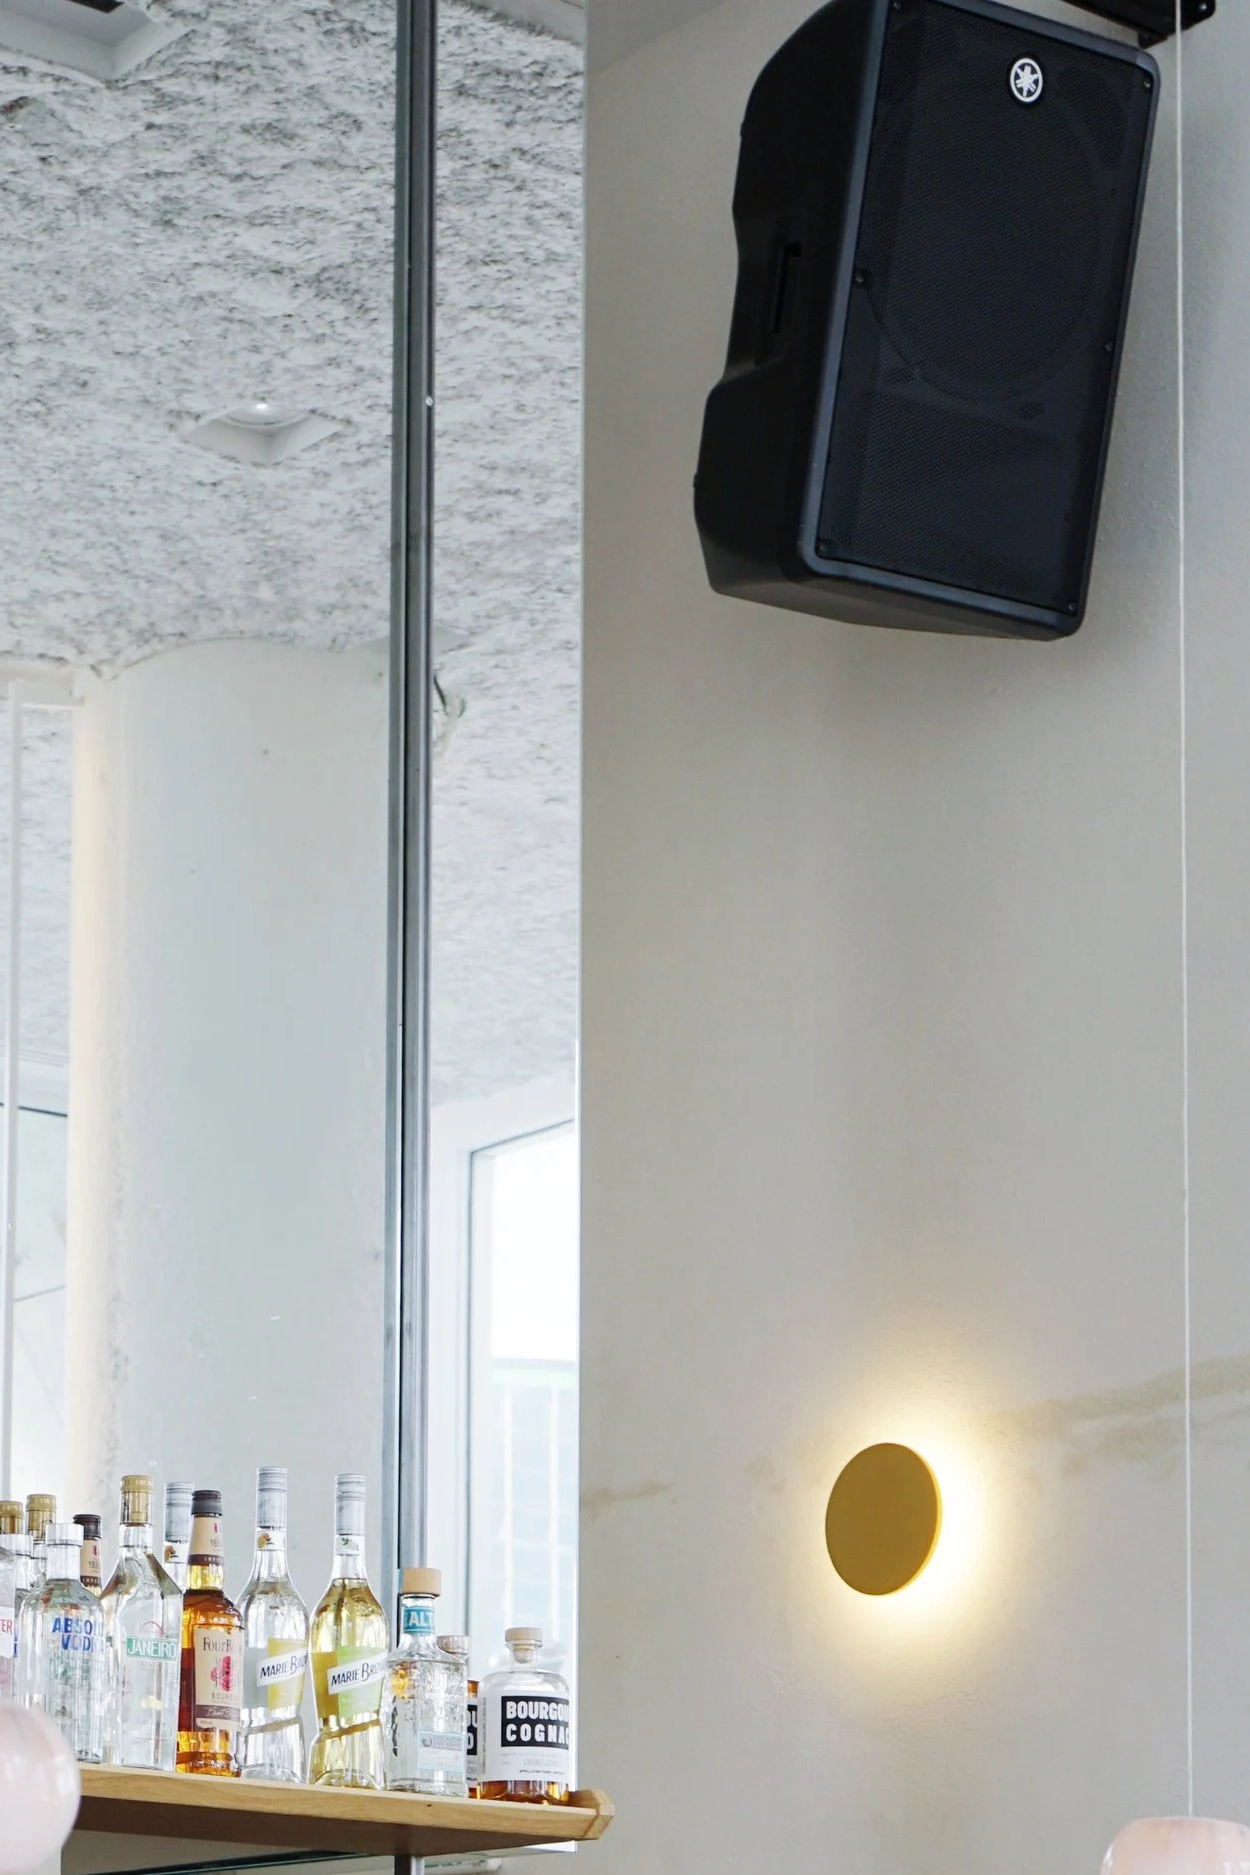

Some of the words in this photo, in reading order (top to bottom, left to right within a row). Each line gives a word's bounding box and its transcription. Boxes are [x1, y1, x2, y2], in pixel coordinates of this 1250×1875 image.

[127, 1638, 177, 1659] JANEIRO
[259, 1662, 290, 1680] MARIE
[331, 1670, 359, 1688] MARIE
